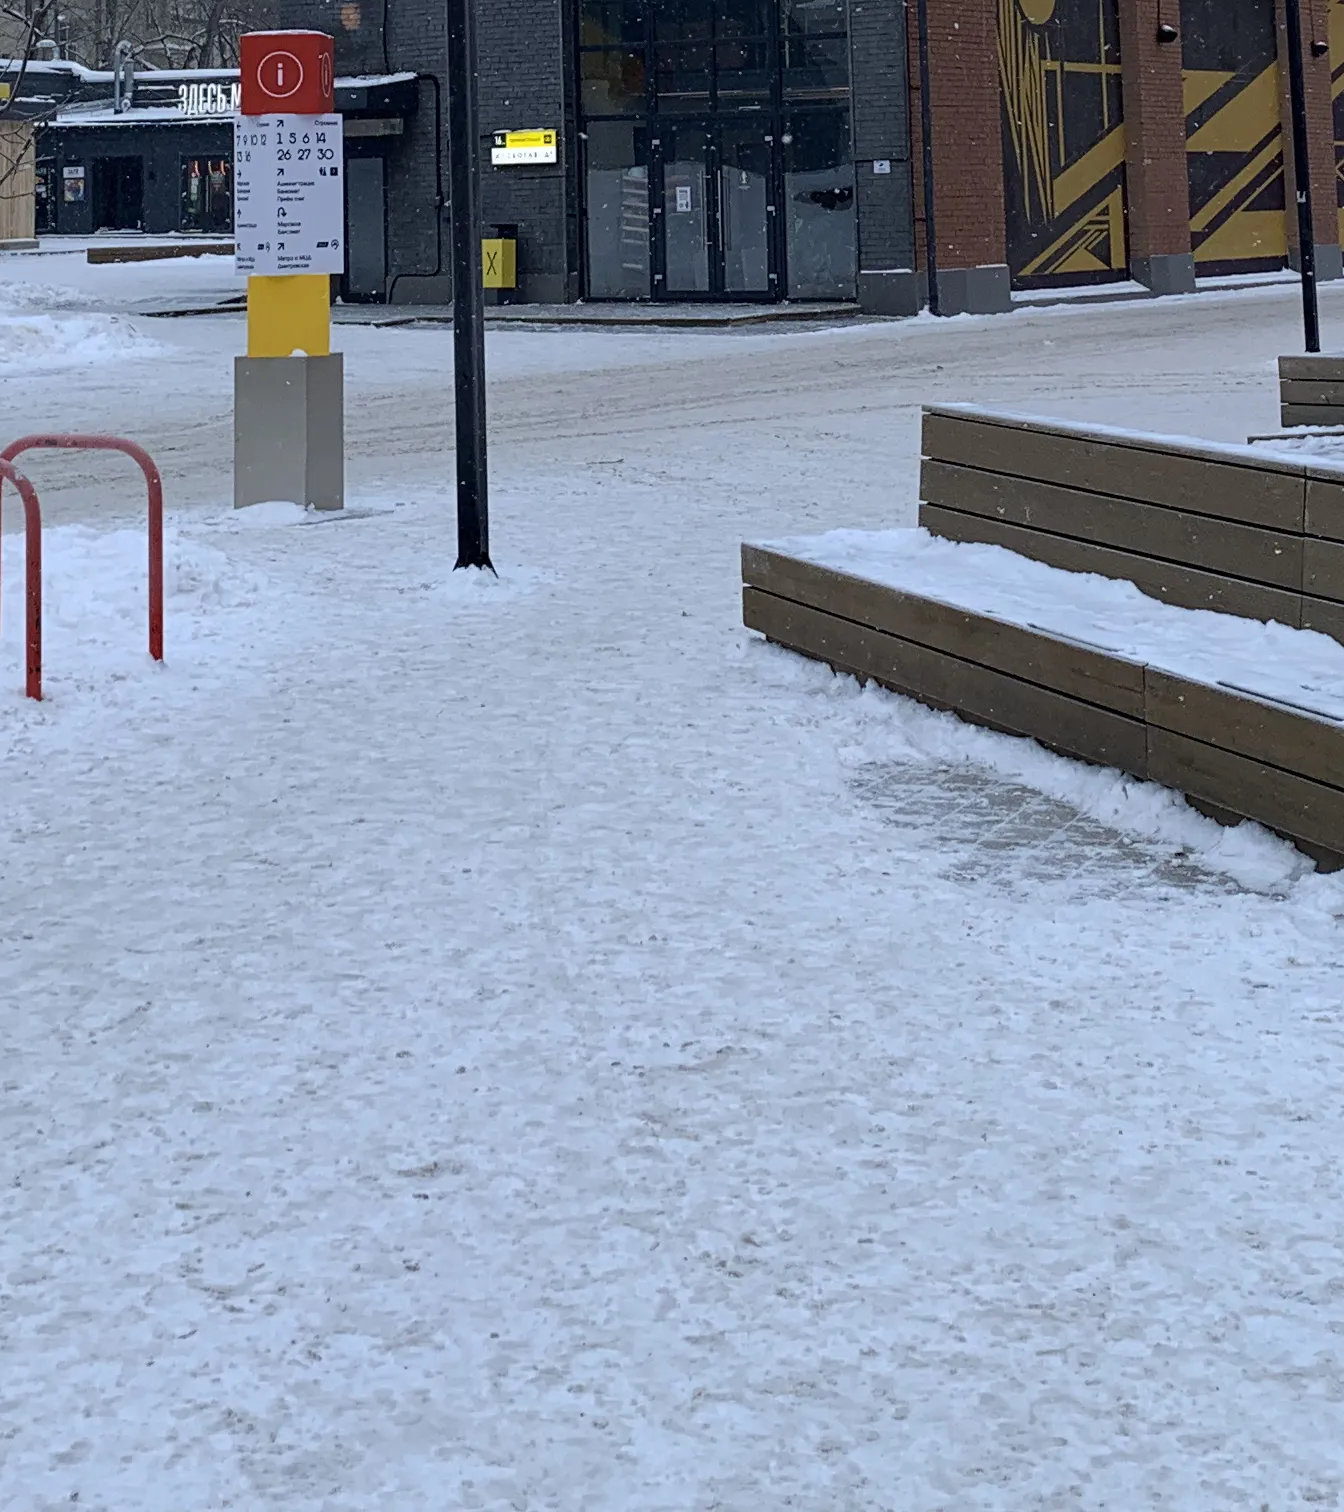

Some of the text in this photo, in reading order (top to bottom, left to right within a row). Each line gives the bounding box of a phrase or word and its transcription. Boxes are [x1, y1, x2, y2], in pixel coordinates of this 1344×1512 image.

[177, 83, 227, 116] ЗДЕСЬ
[276, 132, 326, 145] 1 5 6 14
[276, 148, 335, 161] 26 27 30
